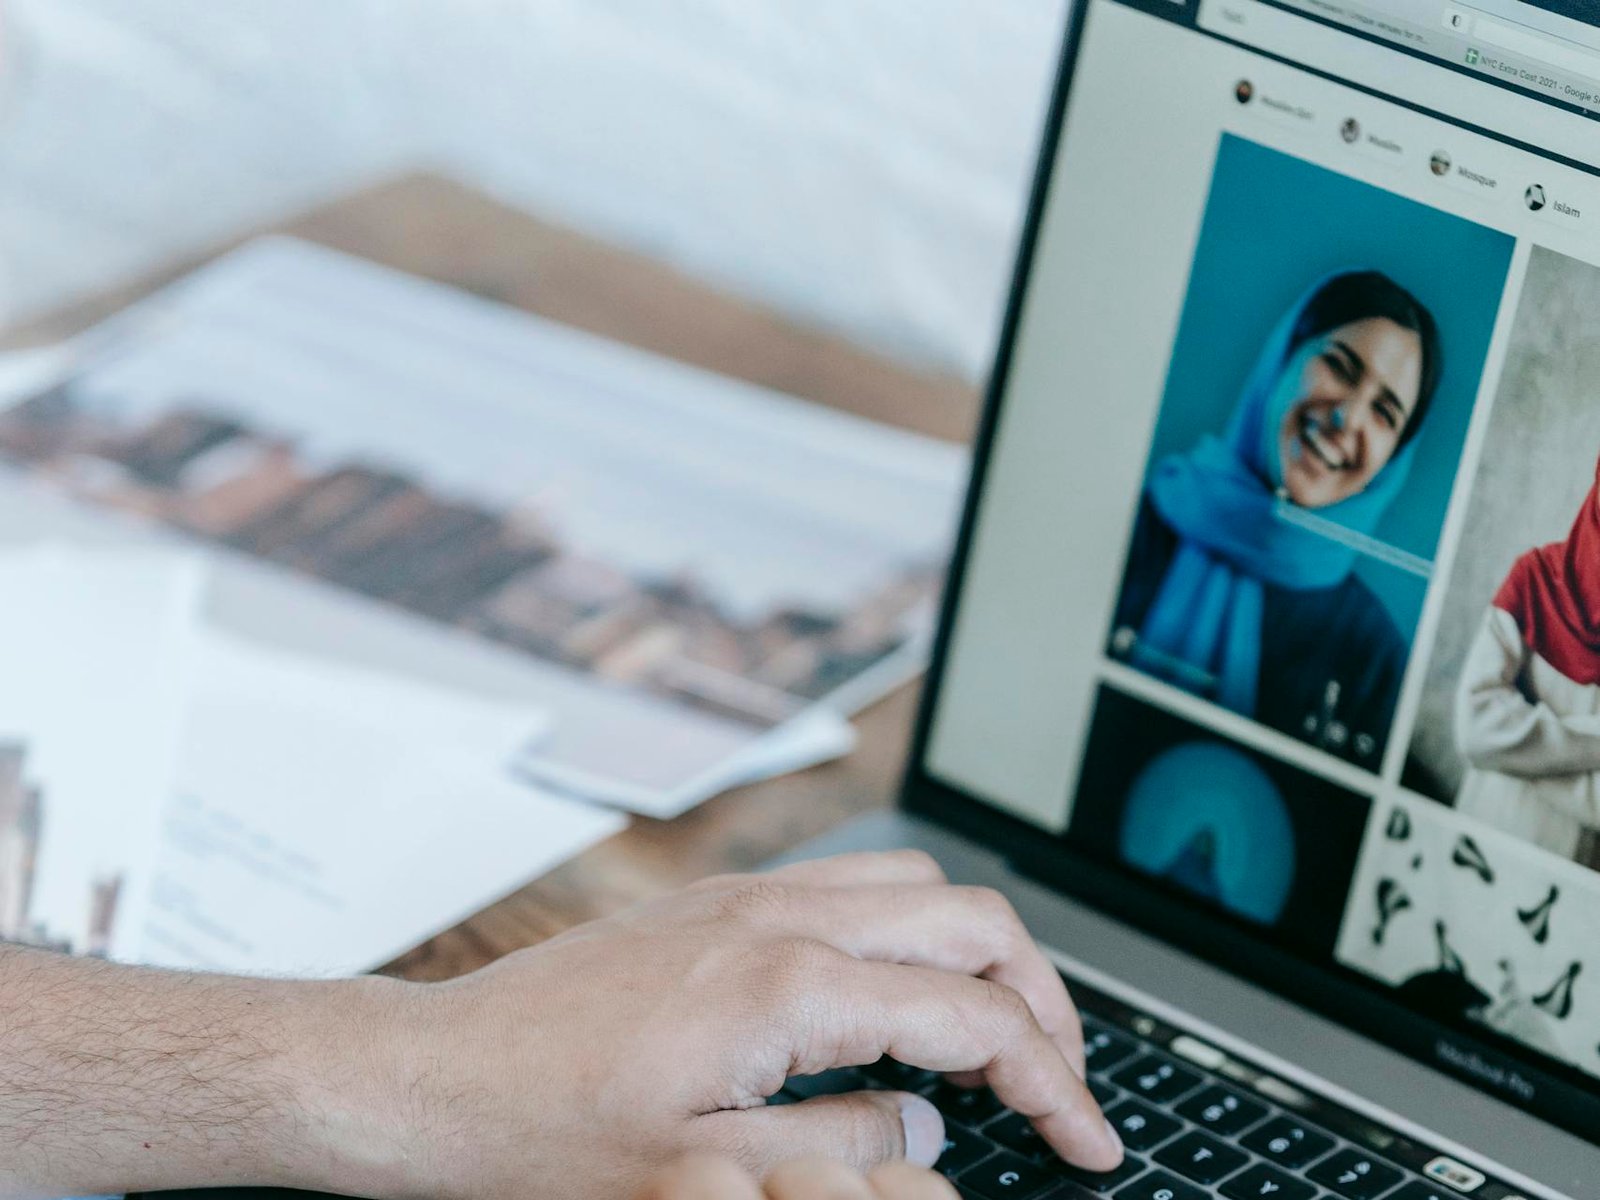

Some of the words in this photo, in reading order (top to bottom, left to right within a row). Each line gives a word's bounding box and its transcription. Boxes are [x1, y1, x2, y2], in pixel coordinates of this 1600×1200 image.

[1481, 56, 1498, 69] NYC
[1499, 62, 1518, 76] Extra
[1519, 70, 1538, 82] Cost
[1538, 76, 1558, 89] 2021
[1564, 84, 1591, 101] Google
[1457, 165, 1497, 188] Mosque
[1552, 200, 1580, 218] Islam
[1194, 1147, 1213, 1162] T
[998, 1171, 1020, 1186] C
[1260, 1180, 1279, 1194] Y
